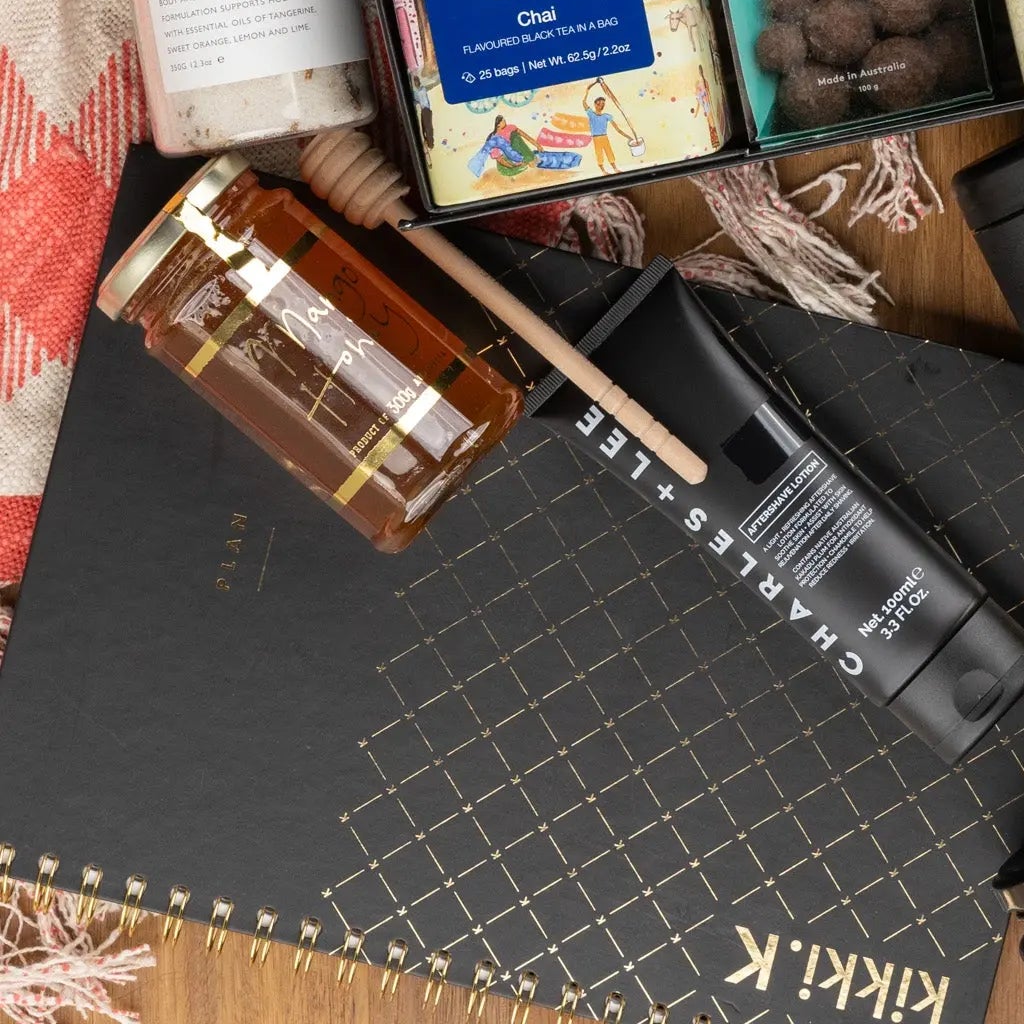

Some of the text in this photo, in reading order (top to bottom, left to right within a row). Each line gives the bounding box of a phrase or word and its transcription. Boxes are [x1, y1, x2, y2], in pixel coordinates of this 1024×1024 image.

[517, 6, 557, 27] Chai
[463, 17, 618, 54] FLAVOURED BLACK TEA BAG
[479, 70, 492, 80] 25
[494, 64, 520, 78] bags
[529, 59, 547, 70] Net
[549, 55, 566, 66] Wt.
[602, 43, 631, 56] 2.2oz
[818, 61, 906, 86] Made in Australia
[386, 388, 417, 414] 300g
[747, 458, 820, 536] AFTERSHAVE LOTION
[216, 513, 248, 593] PLAN
[684, 507, 864, 676] CHARLES
[881, 588, 930, 640] 3.3 Fl. Oz.
